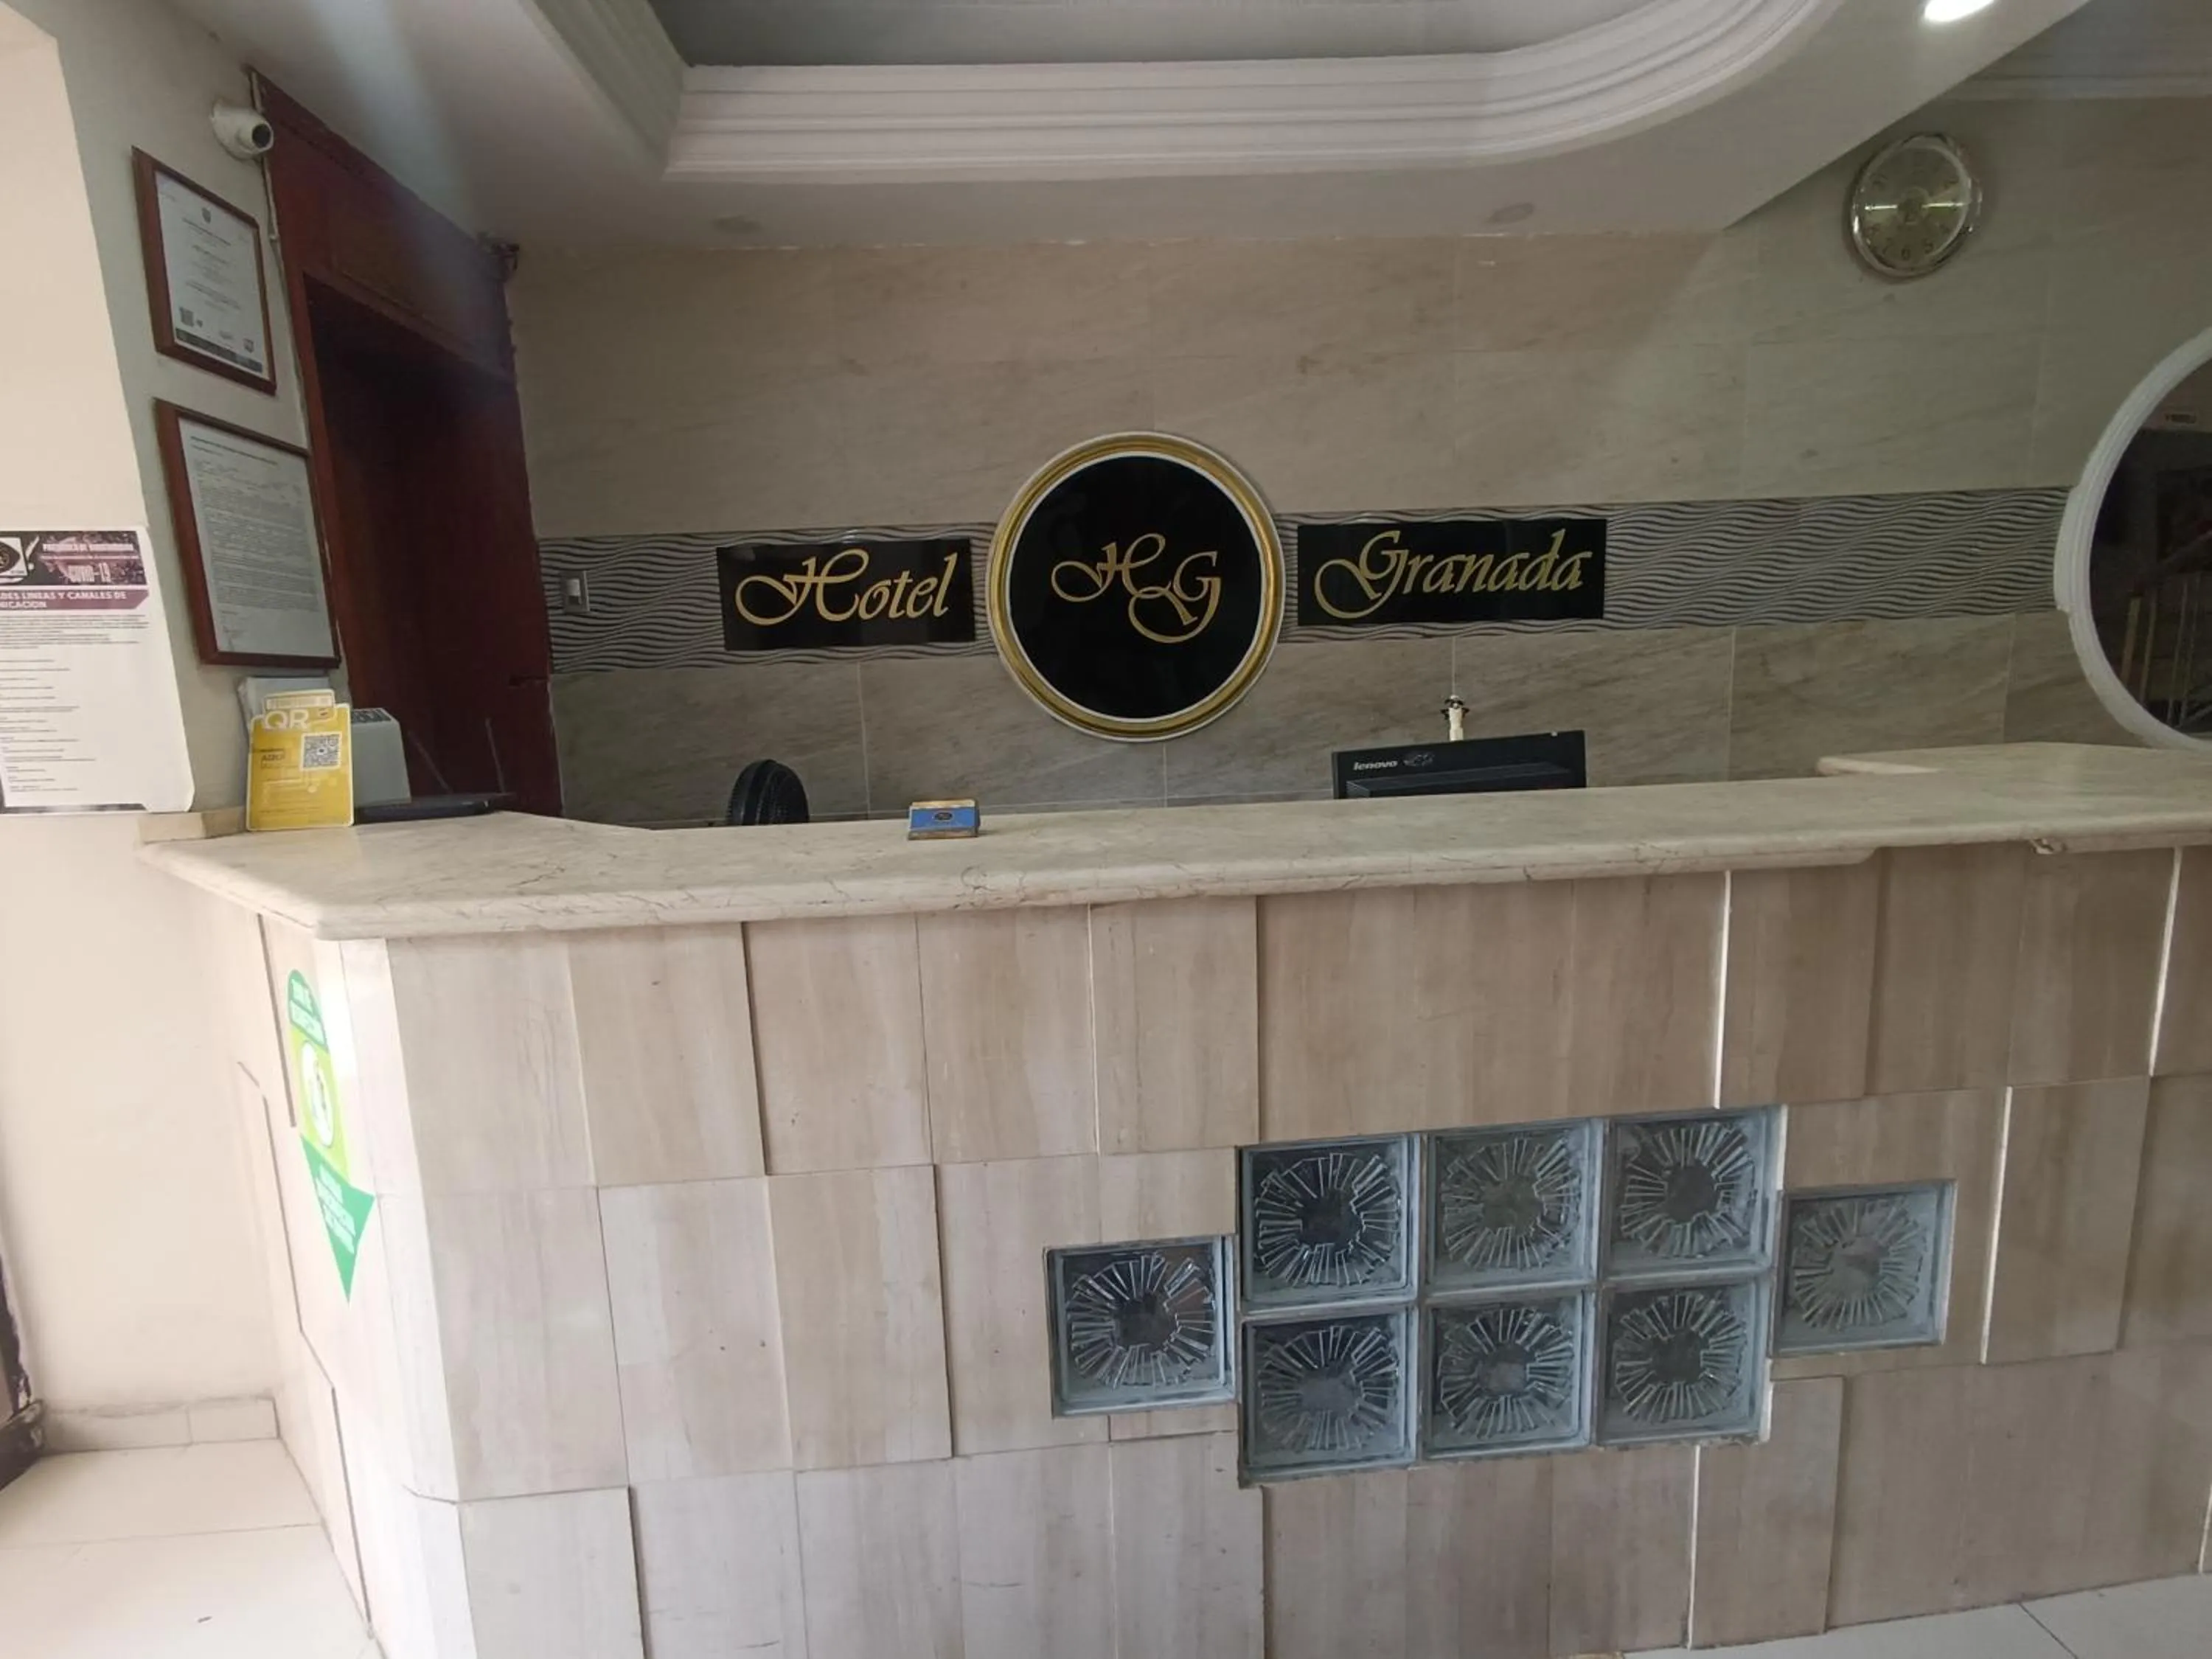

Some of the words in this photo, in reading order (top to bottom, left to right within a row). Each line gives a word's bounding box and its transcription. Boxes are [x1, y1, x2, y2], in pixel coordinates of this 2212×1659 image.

[735, 548, 958, 626] Hotel
[1051, 532, 1221, 644] HG
[1314, 528, 1593, 619] Granada
[265, 709, 309, 731] QR
[1353, 761, 1398, 771] lenovo
